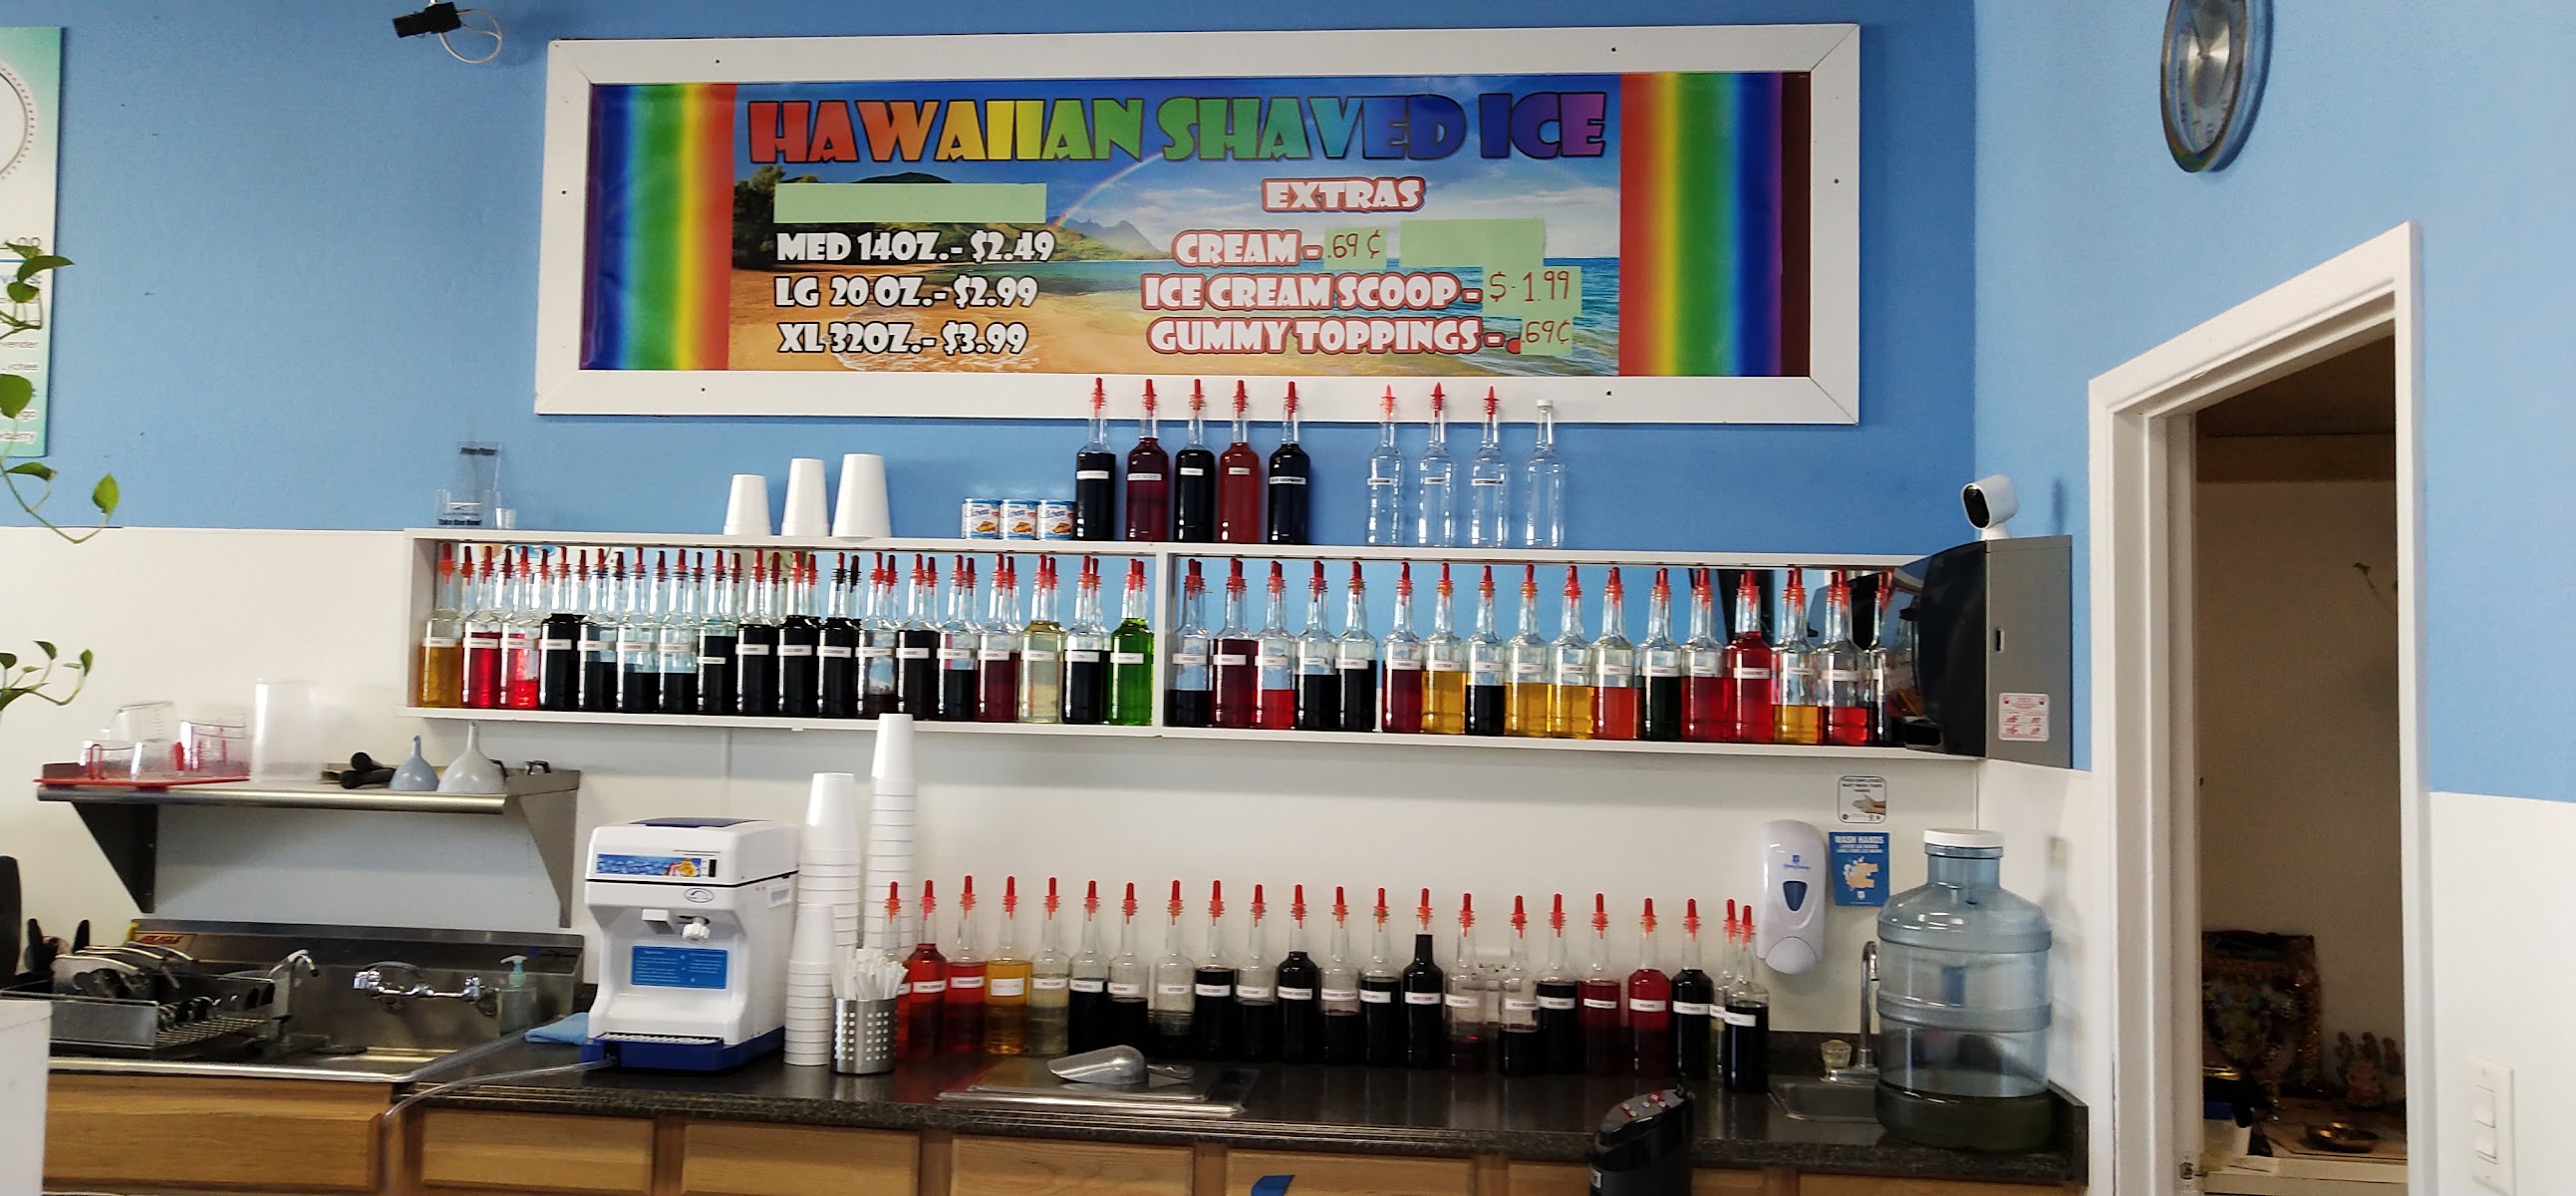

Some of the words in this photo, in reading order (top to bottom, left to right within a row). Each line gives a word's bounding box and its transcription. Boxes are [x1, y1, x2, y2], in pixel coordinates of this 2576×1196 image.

[748, 98, 1145, 162] HAWAIIAN
[1156, 94, 1467, 160] SHAVED
[1479, 92, 1606, 158] ICE
[1264, 178, 1424, 211] EXTRAS
[775, 232, 852, 262] MED
[970, 230, 1055, 263] $2.49
[1174, 231, 1299, 265] CREAM
[774, 276, 820, 307] LG
[953, 274, 1038, 308] $2.99
[1144, 275, 1203, 308] ICE
[1207, 275, 1332, 308] CREAM
[1336, 274, 1460, 308] SCOOP
[777, 322, 826, 353] XL
[942, 321, 1028, 356] $3.99
[1149, 318, 1289, 352] GUMMY
[1294, 318, 1481, 352] TOPPINGS
[1835, 835, 1857, 844] WASH
